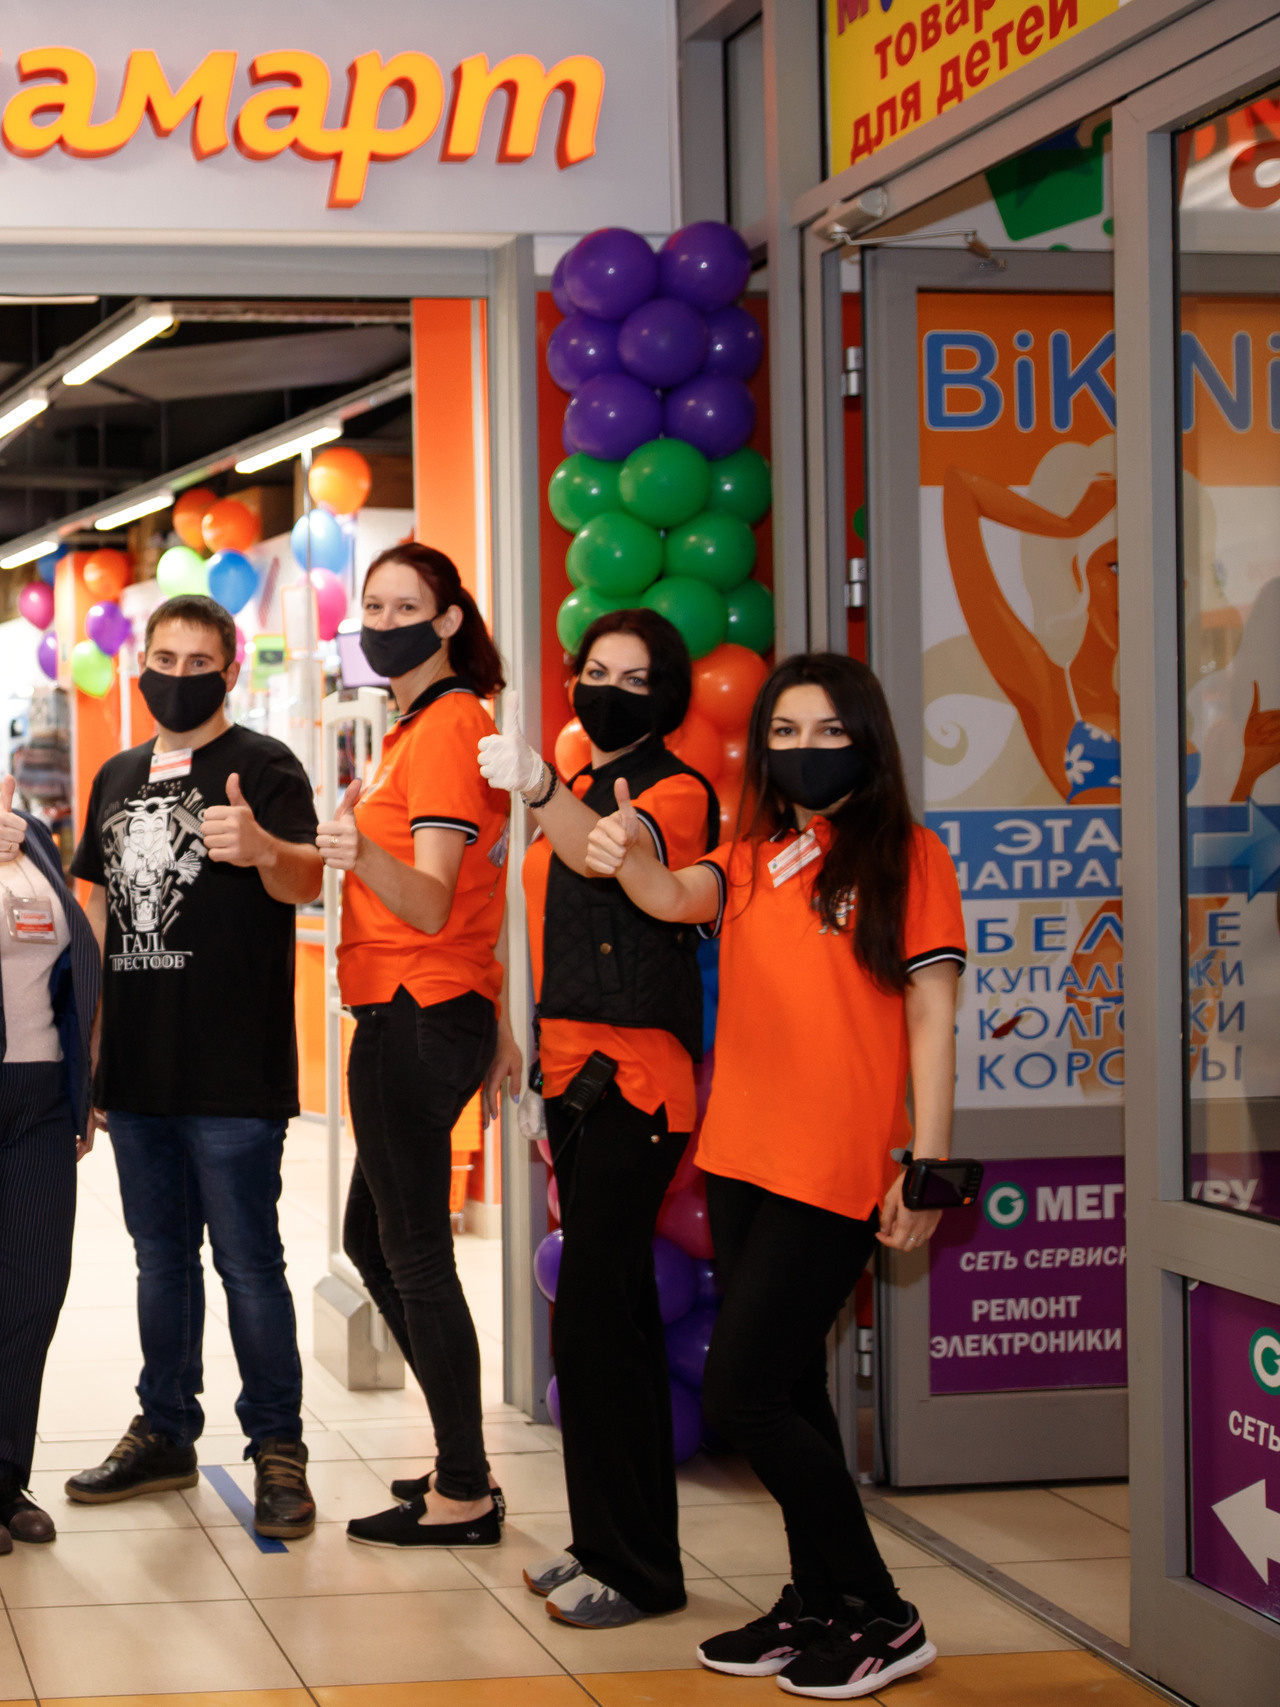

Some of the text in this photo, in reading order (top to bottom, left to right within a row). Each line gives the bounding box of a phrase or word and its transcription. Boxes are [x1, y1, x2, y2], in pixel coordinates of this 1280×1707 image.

[850, 80, 922, 166] для
[992, 818, 1122, 856] ЭТА
[960, 1250, 1018, 1272] СЕТЬ
[972, 1295, 1082, 1322] РЕМОНТ
[929, 1328, 1123, 1358] ЭЛЕКТРОНИКИ
